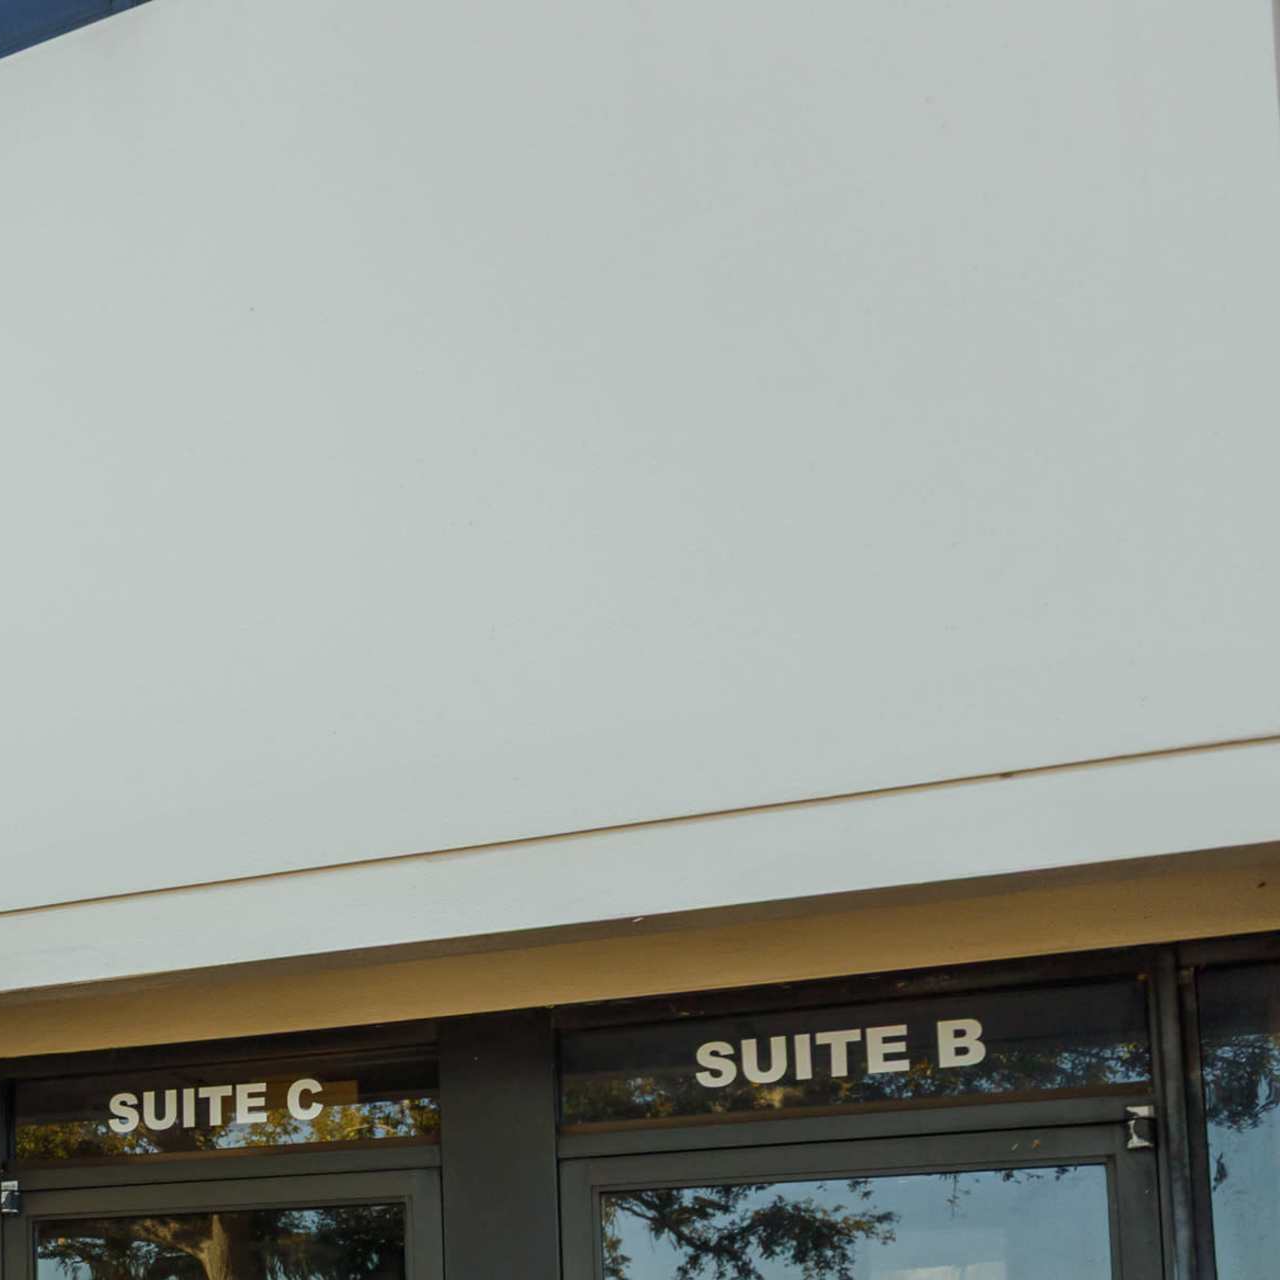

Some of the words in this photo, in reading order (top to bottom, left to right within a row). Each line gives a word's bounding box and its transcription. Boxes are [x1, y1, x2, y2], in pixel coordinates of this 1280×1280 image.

[695, 1022, 911, 1089] SUITE
[937, 1018, 987, 1069] B
[107, 1081, 268, 1134] SUITE
[286, 1078, 324, 1122] C
